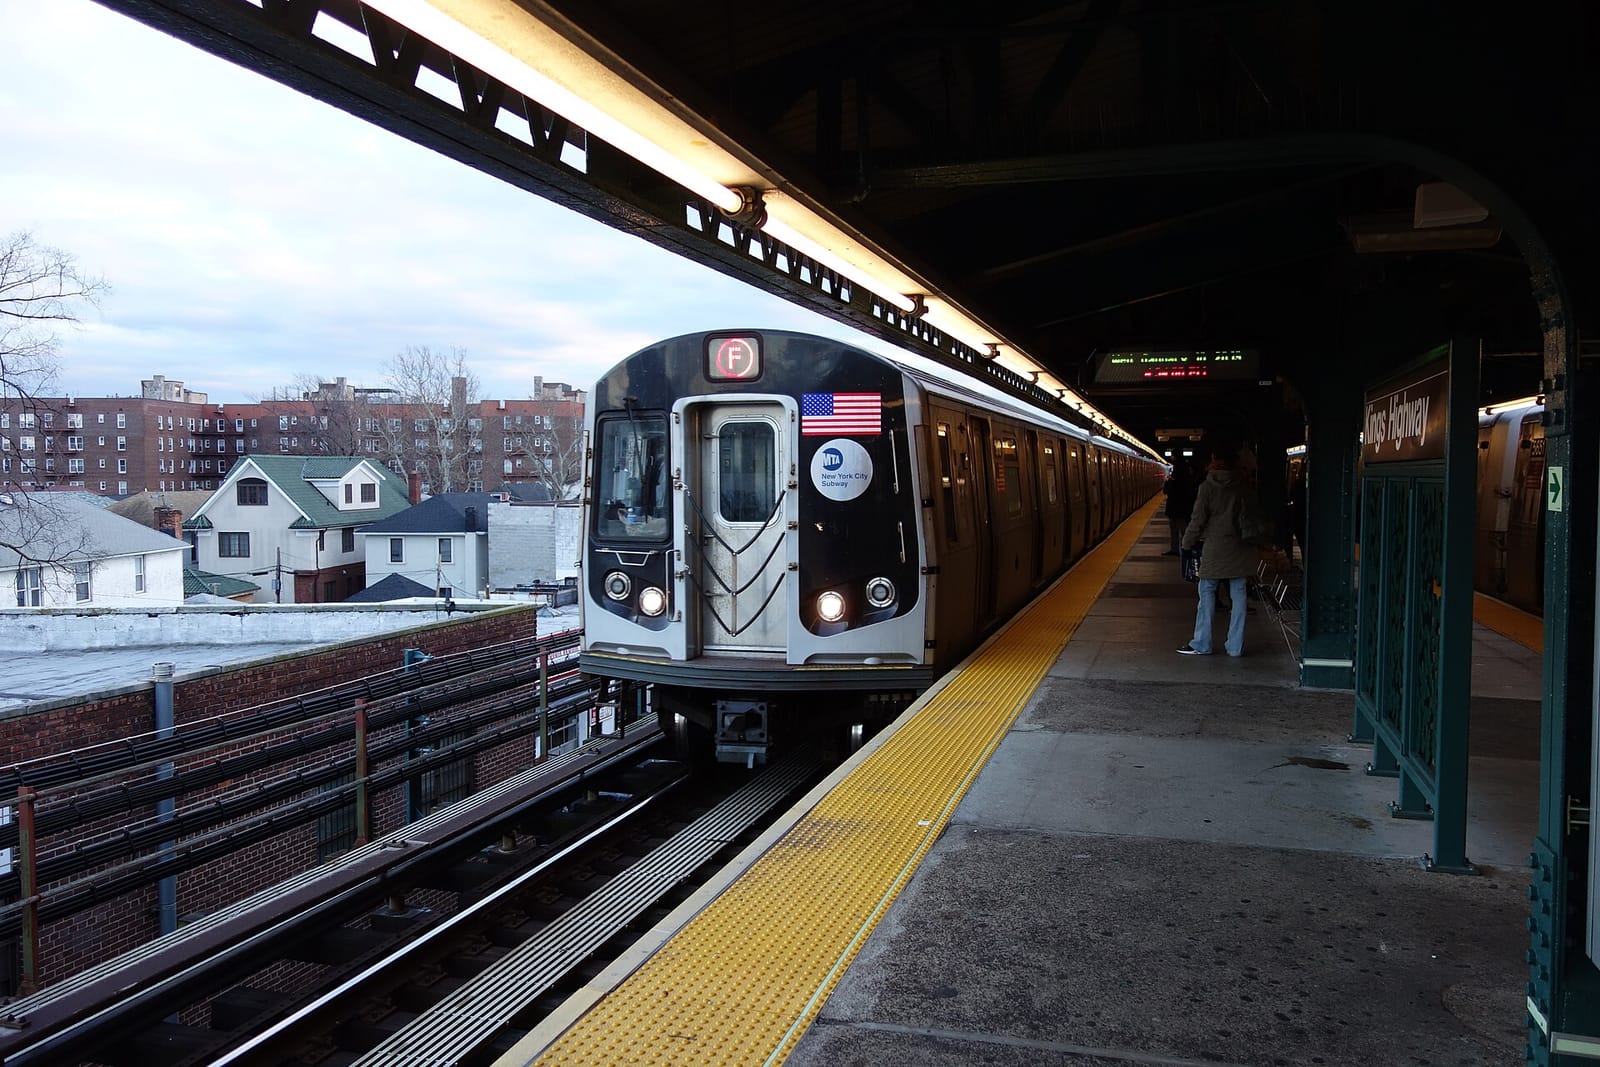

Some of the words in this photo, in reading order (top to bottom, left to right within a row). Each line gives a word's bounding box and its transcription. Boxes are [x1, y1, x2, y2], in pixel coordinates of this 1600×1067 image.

[728, 346, 741, 370] F
[1364, 403, 1386, 454] Kings
[1387, 391, 1429, 451] Highway
[822, 451, 841, 467] MTA
[821, 480, 849, 488] Subway
[854, 473, 868, 481] City
